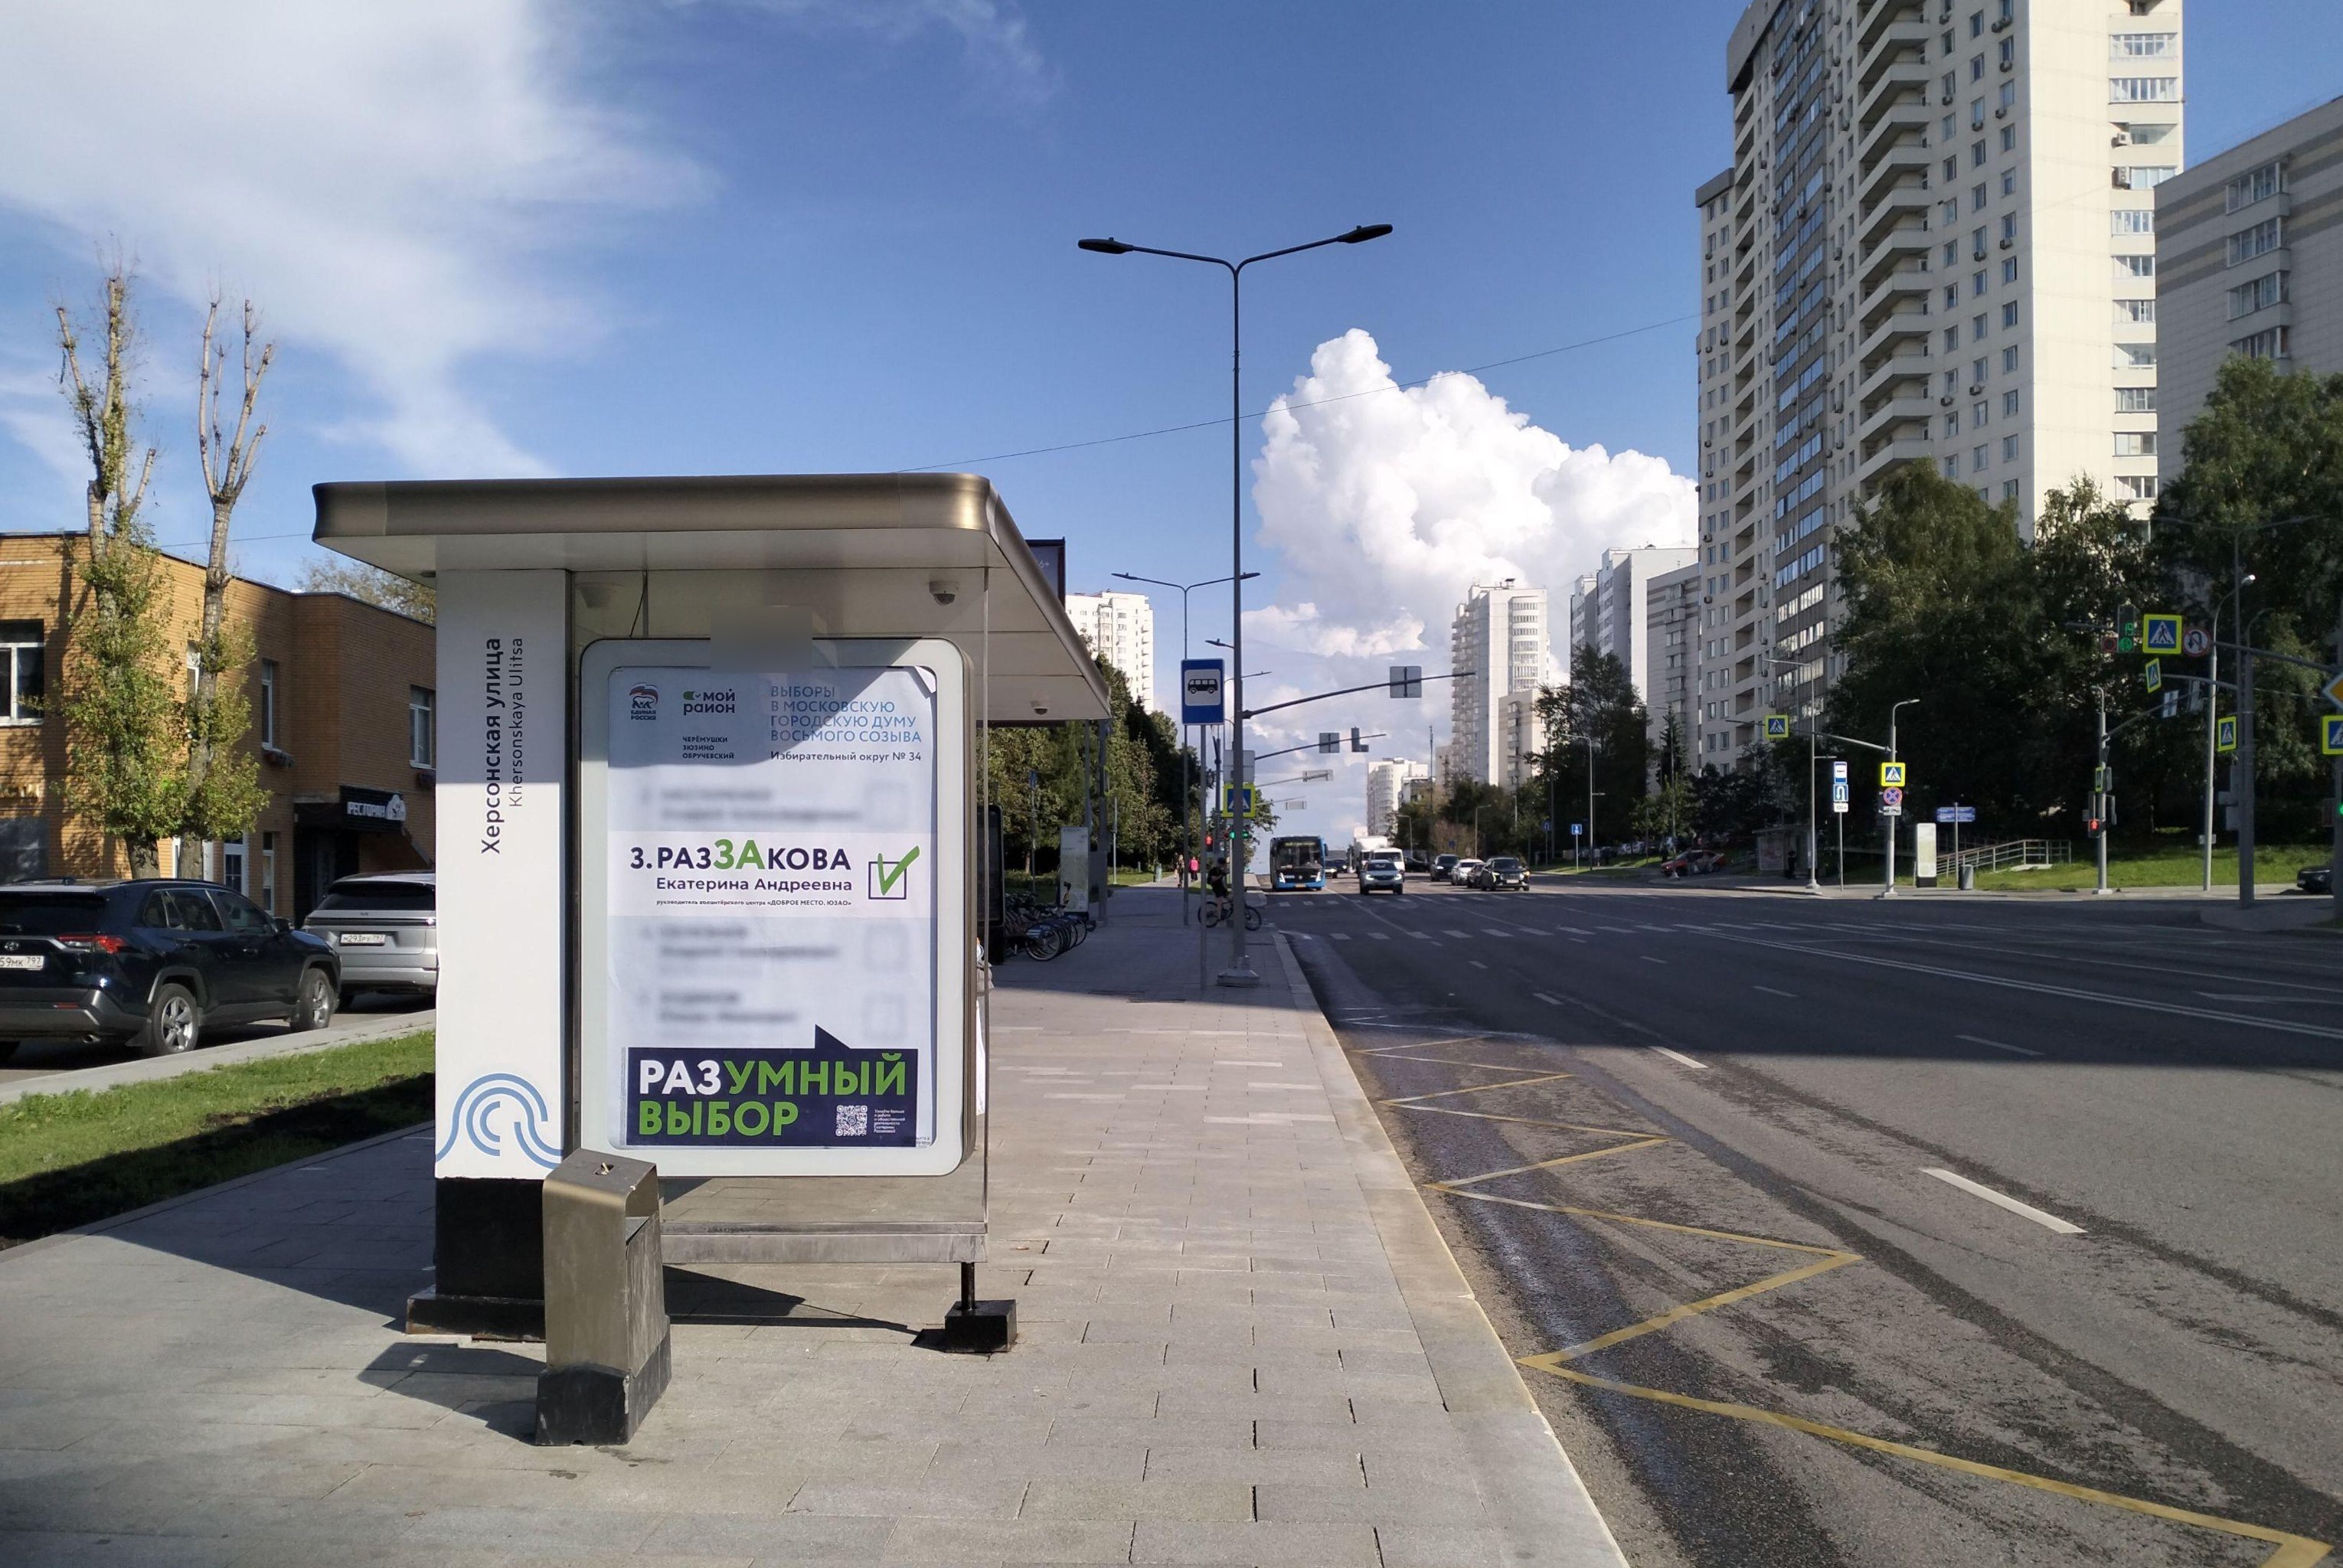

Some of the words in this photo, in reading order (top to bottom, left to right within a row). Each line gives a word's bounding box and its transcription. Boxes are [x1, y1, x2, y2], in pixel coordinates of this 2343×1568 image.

[508, 638, 523, 687] Ulitsa
[486, 638, 505, 708] улица
[703, 688, 736, 702] мой
[770, 686, 835, 697] ВЫБОРЫ
[683, 703, 736, 716] район
[770, 701, 779, 712] В
[783, 701, 895, 713] МОСКОВСКУЮ
[770, 715, 868, 729] ГОРОДСКУЮ
[871, 716, 917, 729] ДУМУ
[770, 730, 855, 742] ВОСЬМОГО
[859, 730, 922, 743] СОЗЫВА
[508, 691, 525, 807] Khersonskaya
[770, 750, 857, 763] Избирательный
[859, 753, 890, 763] округ
[892, 752, 906, 760] №
[909, 752, 922, 761] 34
[482, 714, 505, 854] Херсонская
[657, 838, 851, 871] РАЗЗАКОВА
[656, 877, 750, 892] Екатерина
[754, 877, 852, 893] Андреевна
[639, 1052, 906, 1095] РАЗУМНЫЙ
[639, 1100, 799, 1136] ВЫБОР
